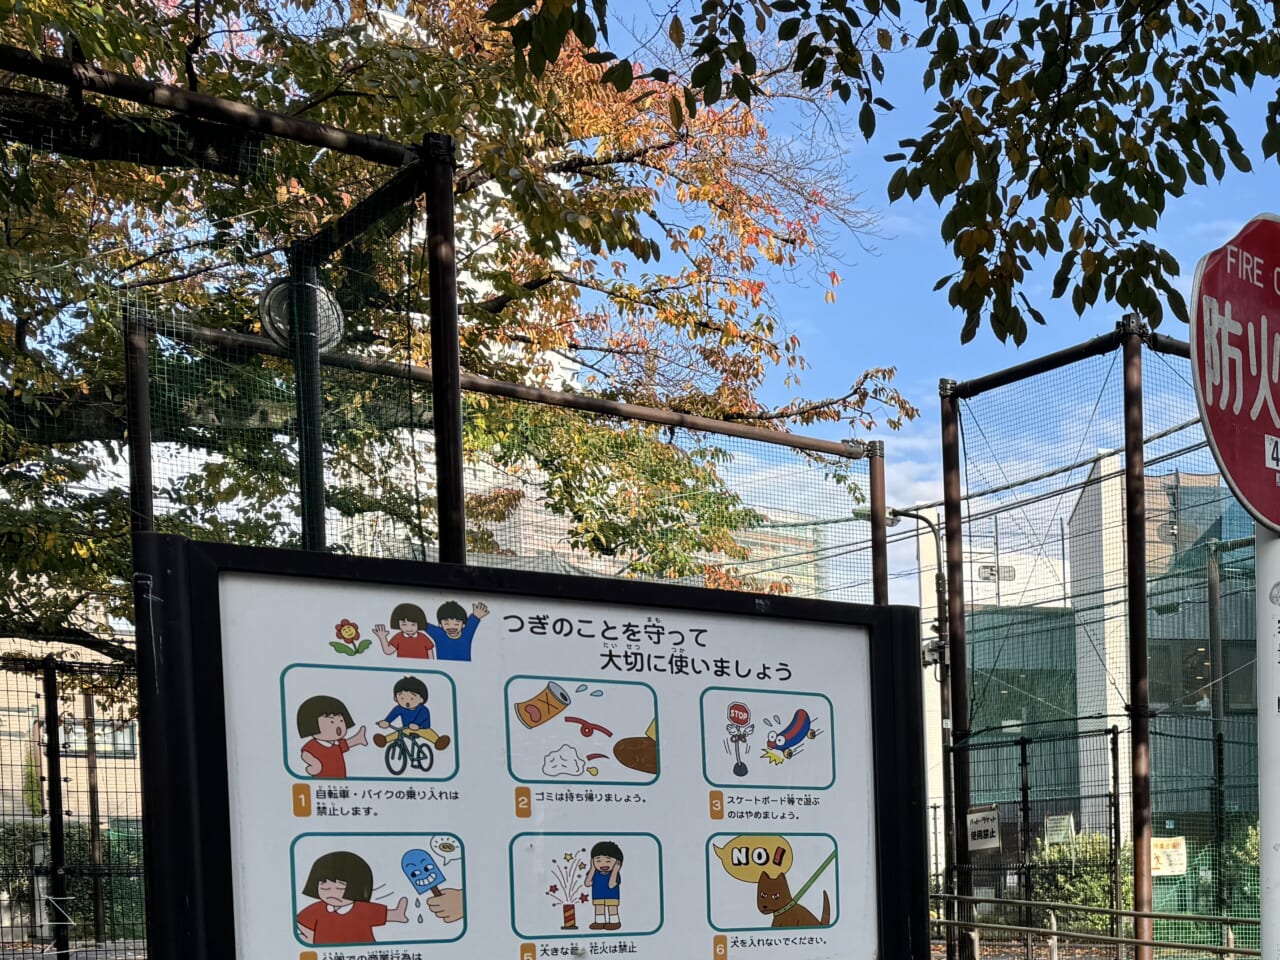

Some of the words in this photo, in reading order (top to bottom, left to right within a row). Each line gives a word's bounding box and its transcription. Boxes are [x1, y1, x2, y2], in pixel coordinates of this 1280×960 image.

[1226, 244, 1264, 288] FIRE
[503, 614, 708, 647] つぎのことを守って
[600, 650, 793, 680] 大切に使いましょう
[730, 710, 748, 720] STOP
[298, 794, 306, 807] 1
[518, 796, 528, 808] 2
[535, 792, 646, 803] ゴミは持ち帰りましょう。
[712, 800, 721, 811] 3
[727, 810, 799, 819] のはやめましょう。
[730, 936, 826, 948] 犬を入れないでください。
[540, 944, 637, 957] 大きな音花火は禁止
[716, 944, 725, 955] 6
